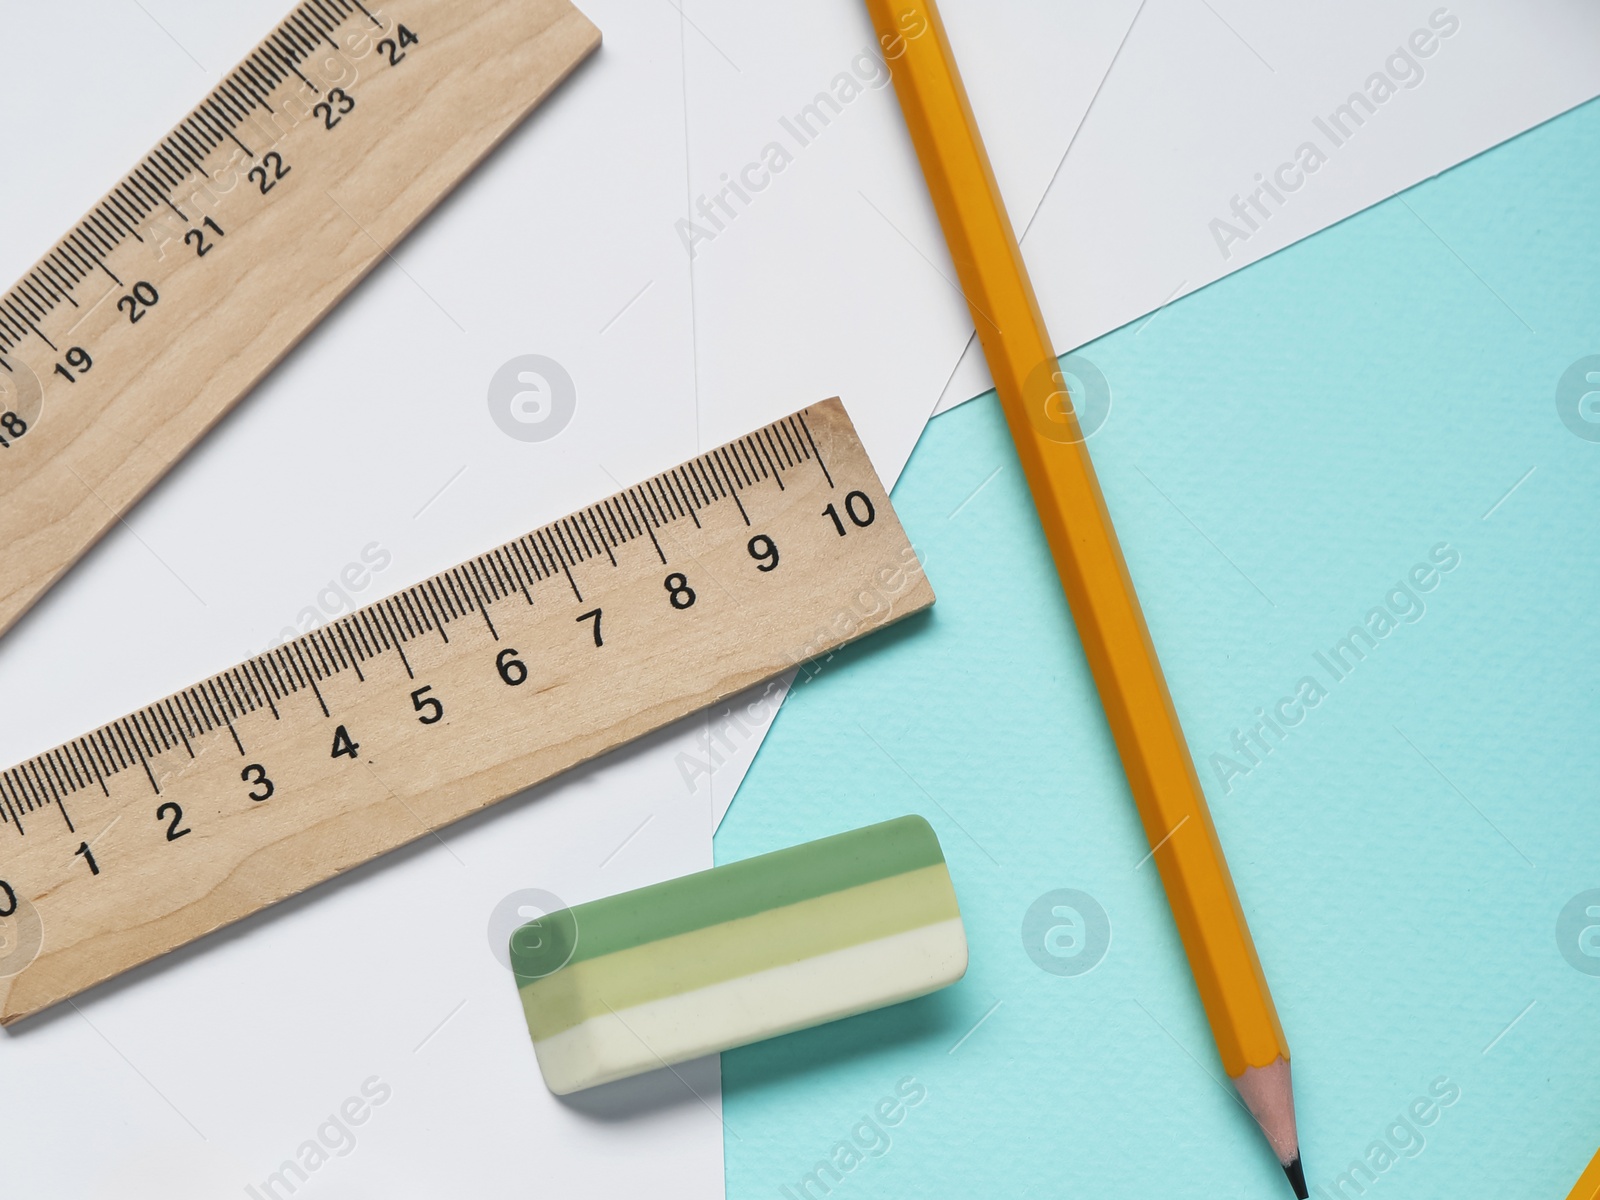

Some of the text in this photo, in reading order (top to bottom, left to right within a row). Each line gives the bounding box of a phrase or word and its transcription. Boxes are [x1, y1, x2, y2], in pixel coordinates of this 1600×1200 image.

[54, 347, 92, 382] 19
[118, 282, 158, 323] 20
[185, 217, 224, 257] 21
[248, 152, 291, 194] 22
[313, 88, 354, 130] 23
[377, 25, 418, 66] 24
[75, 842, 99, 875] 1
[157, 802, 191, 841] 2
[241, 764, 274, 801] 3
[331, 725, 359, 758] 4
[411, 685, 443, 724] 5
[496, 649, 527, 686] 6
[576, 608, 603, 647] 7
[664, 573, 695, 609] 8
[748, 535, 779, 572] 9
[822, 491, 875, 536] 10
